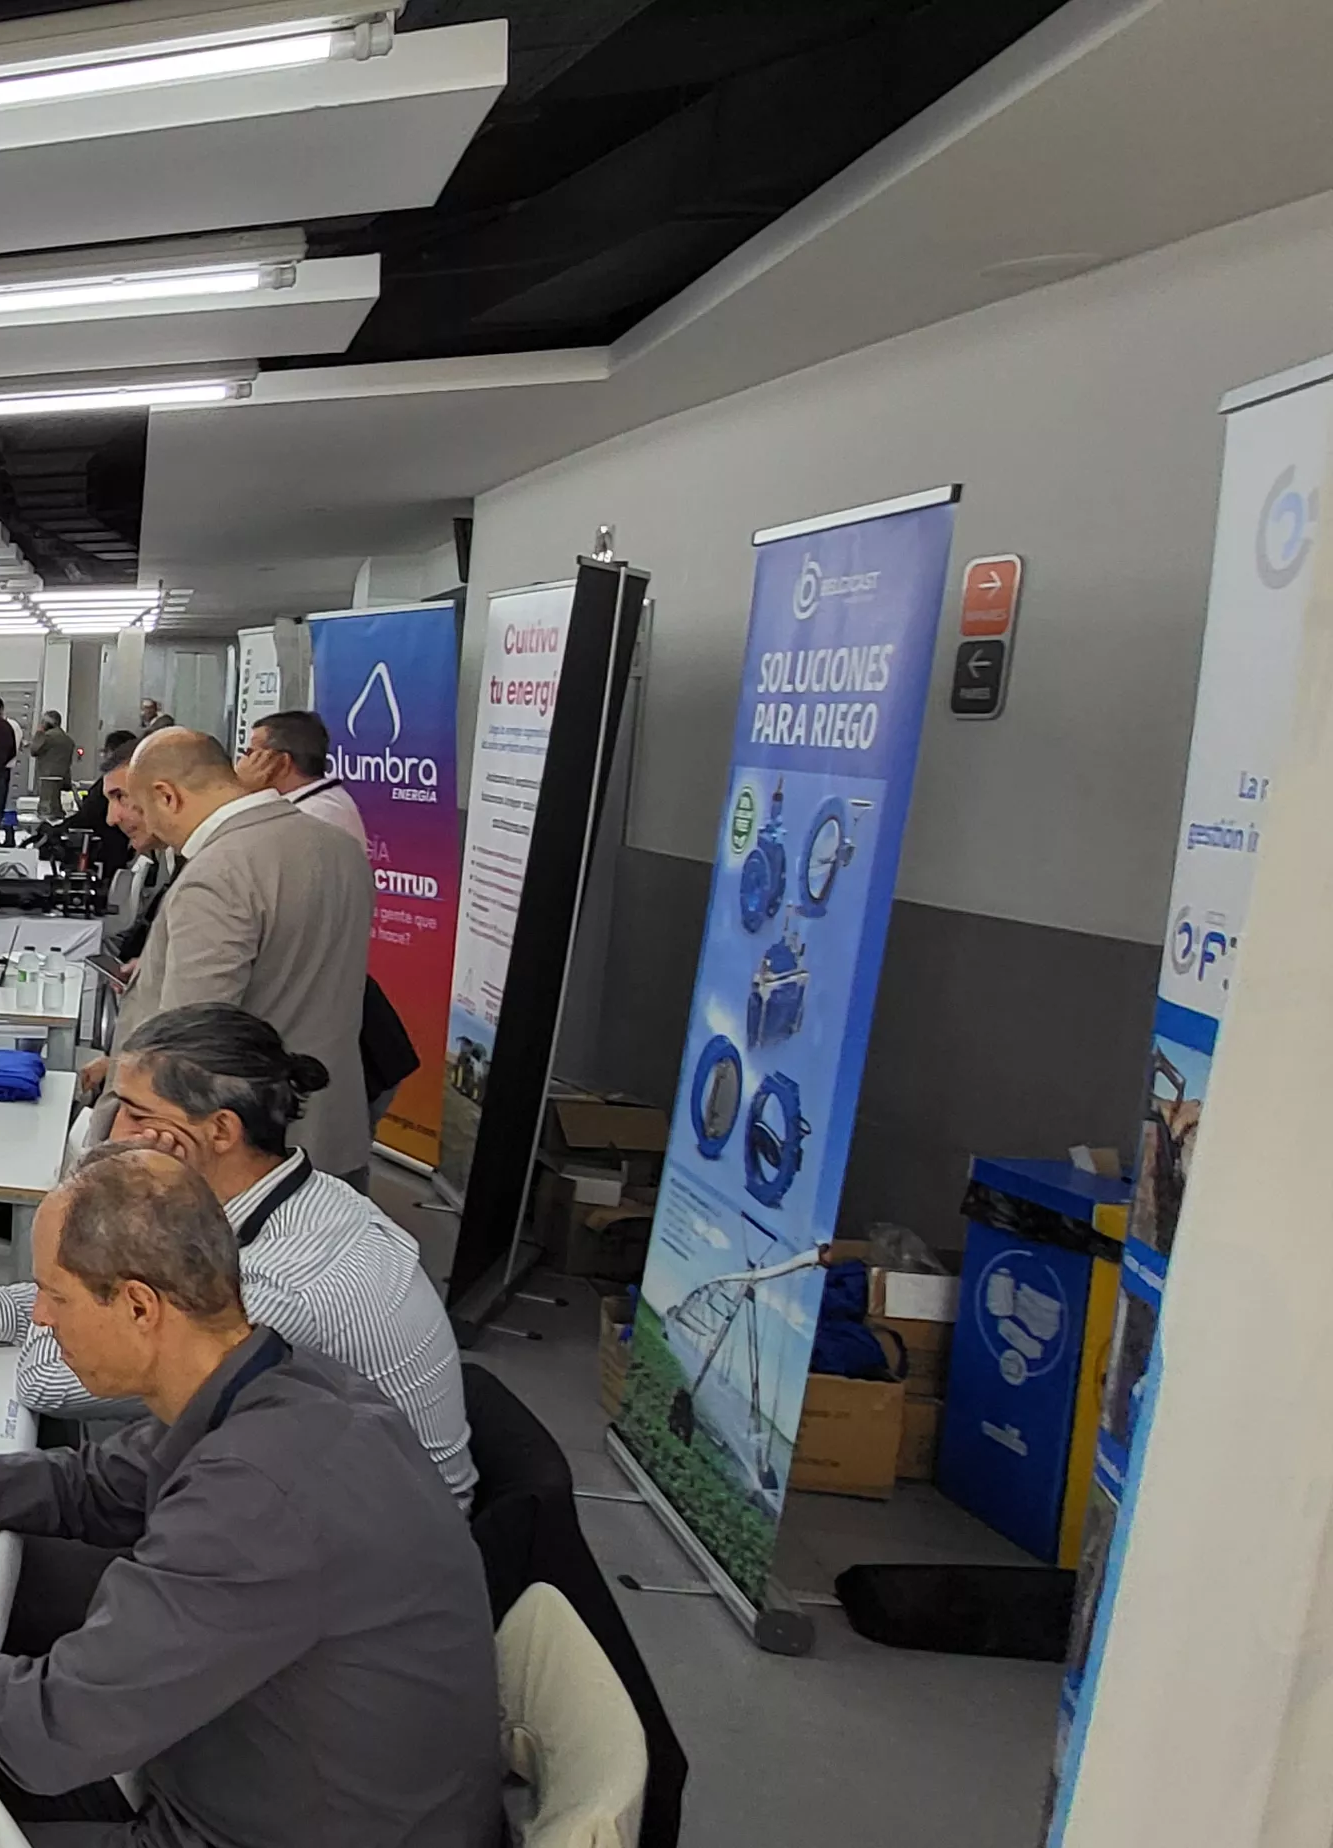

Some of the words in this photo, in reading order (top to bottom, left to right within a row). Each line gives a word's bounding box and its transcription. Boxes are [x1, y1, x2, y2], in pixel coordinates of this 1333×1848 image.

[504, 620, 559, 655] Cultiva
[757, 644, 894, 693] SOLUCIONES
[490, 675, 504, 705] tu
[750, 703, 807, 746] PARA
[809, 703, 879, 750] RIEGO
[324, 745, 438, 787] alumbra
[392, 787, 438, 803] ENERGÍA
